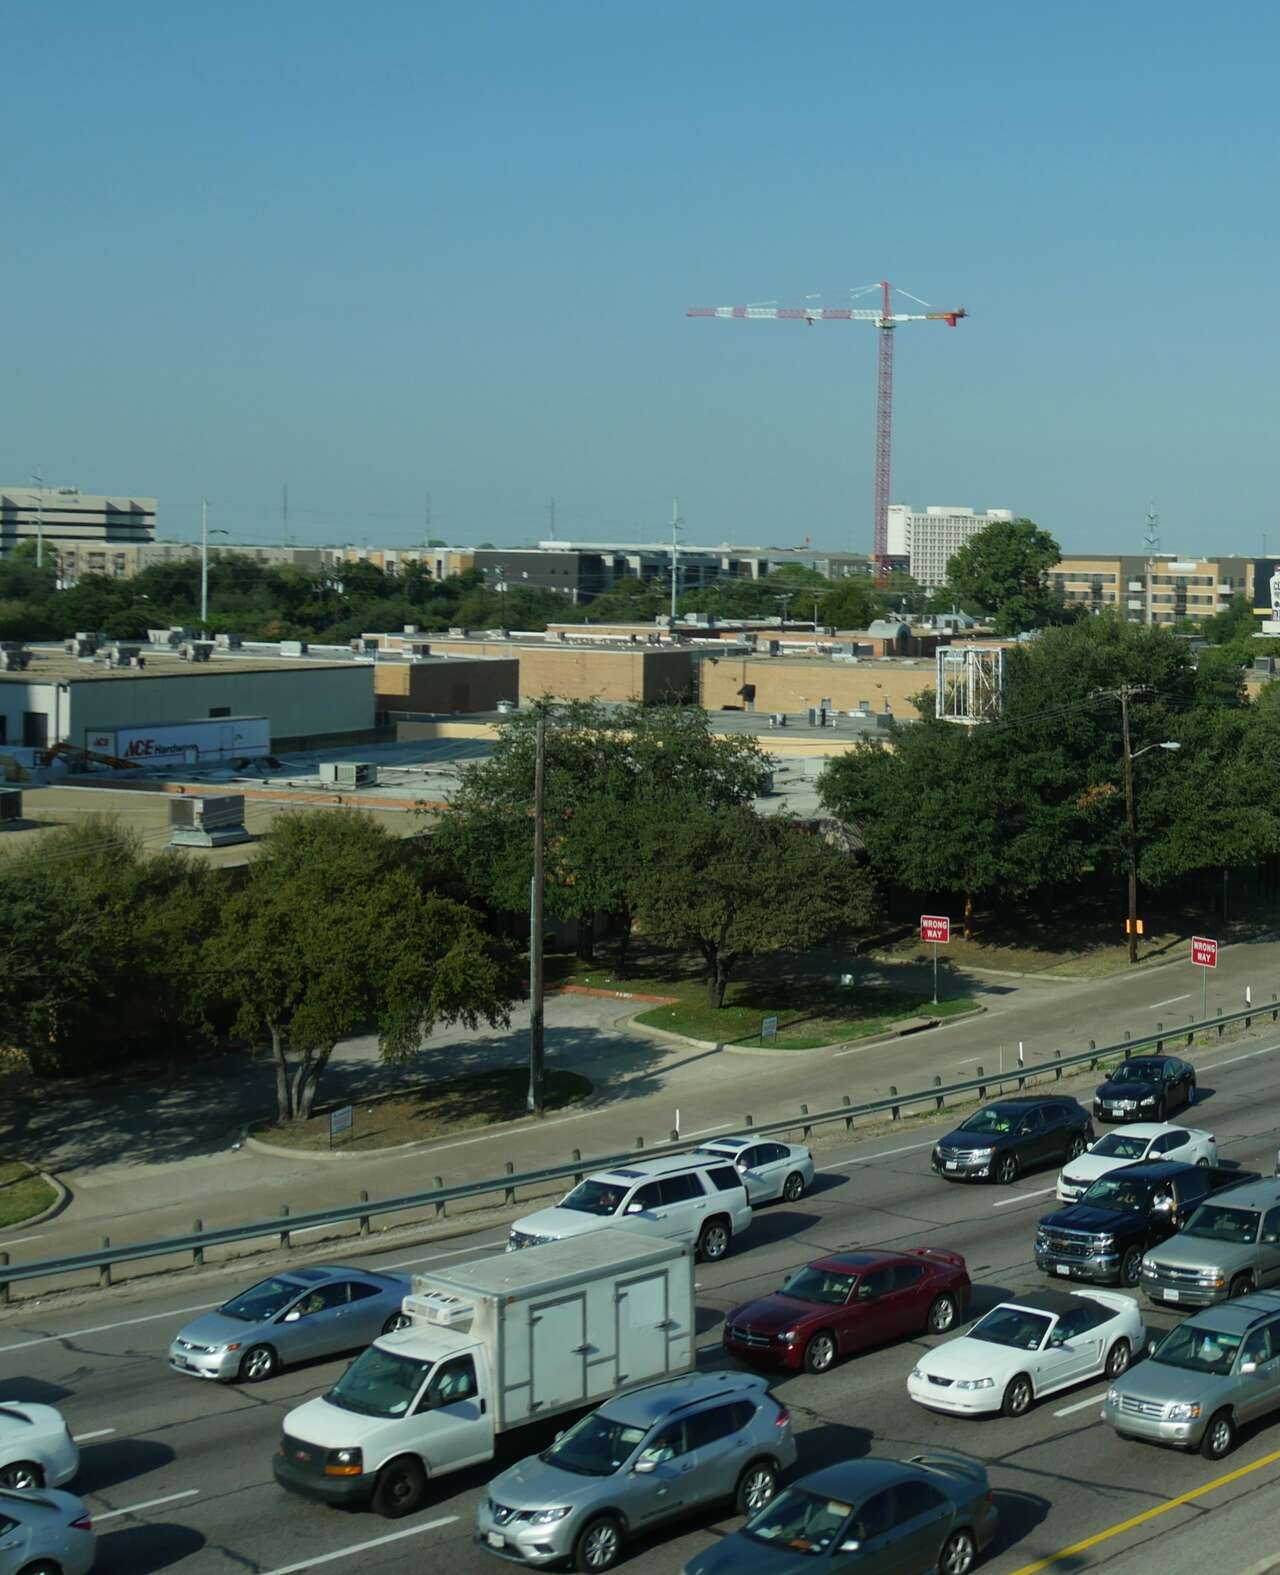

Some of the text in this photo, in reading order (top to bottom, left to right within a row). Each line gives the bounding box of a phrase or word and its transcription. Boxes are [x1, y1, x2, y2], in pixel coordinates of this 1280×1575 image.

[124, 740, 155, 757] ACE
[922, 919, 947, 929] WRONG
[927, 930, 942, 938] WAY
[1194, 941, 1215, 953] WRONG
[1197, 952, 1211, 962] WAY
